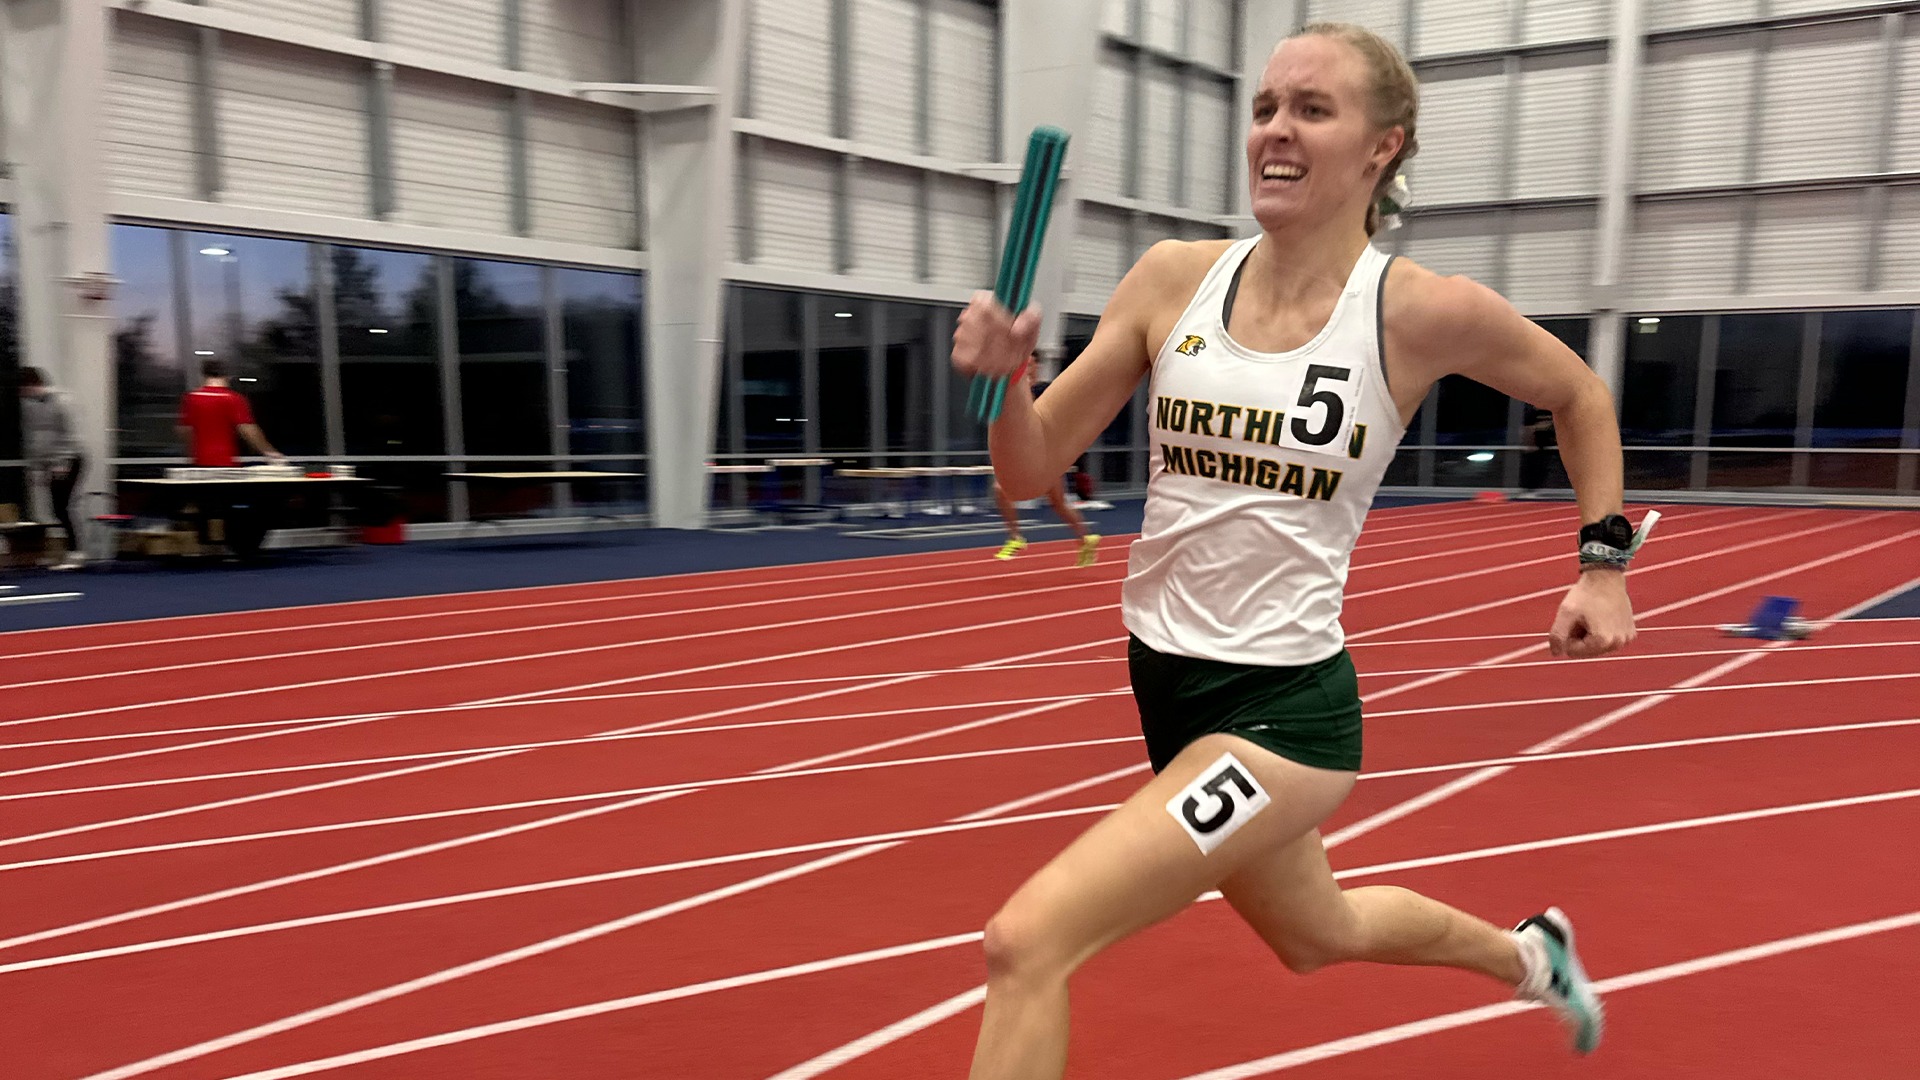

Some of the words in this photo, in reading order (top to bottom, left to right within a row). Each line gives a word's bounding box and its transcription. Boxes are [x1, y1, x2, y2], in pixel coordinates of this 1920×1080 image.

[1156, 396, 1367, 459] NORTHN
[1291, 364, 1351, 446] 5
[1160, 443, 1343, 501] MICHIGAN
[1182, 763, 1257, 833] 5
